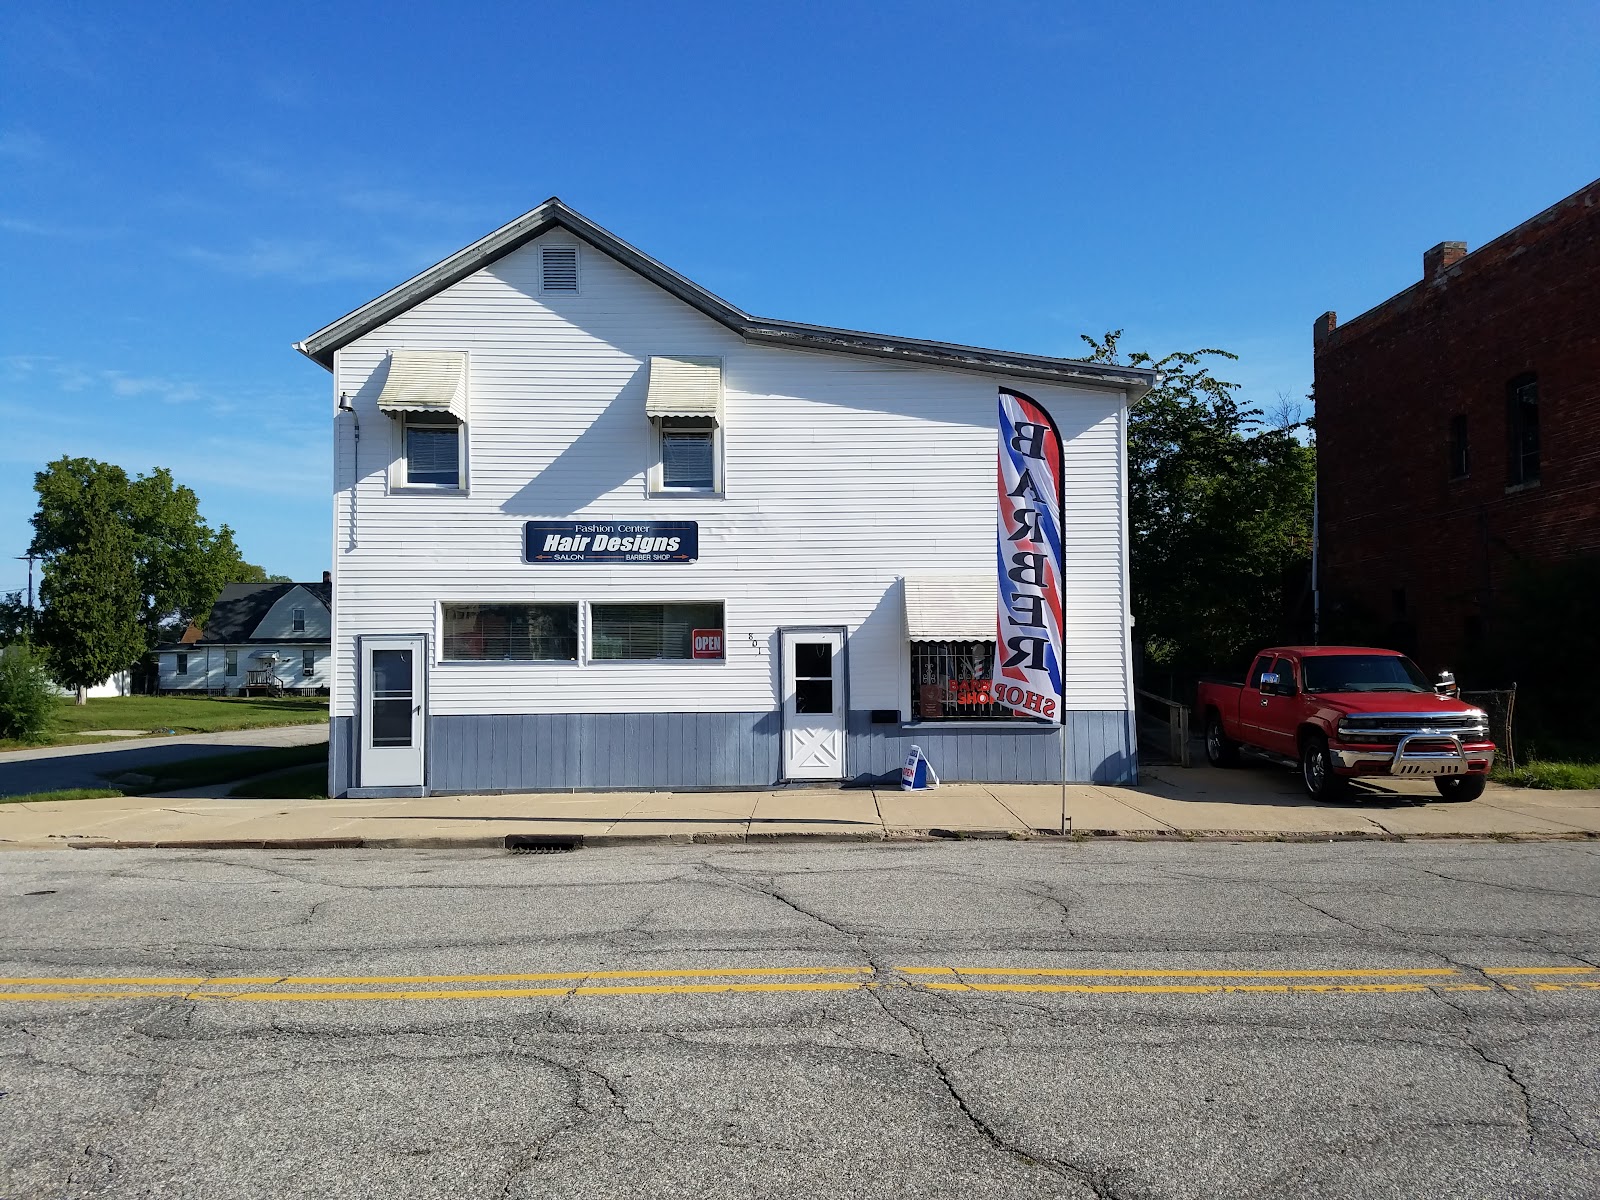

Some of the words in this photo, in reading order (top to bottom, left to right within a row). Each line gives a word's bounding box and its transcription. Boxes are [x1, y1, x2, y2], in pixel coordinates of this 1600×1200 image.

[575, 524, 614, 533] Fashion
[617, 524, 650, 533] Center
[543, 534, 591, 552] Hair
[592, 534, 681, 554] Designs
[695, 636, 721, 651] OPEN
[949, 679, 993, 692] BARB
